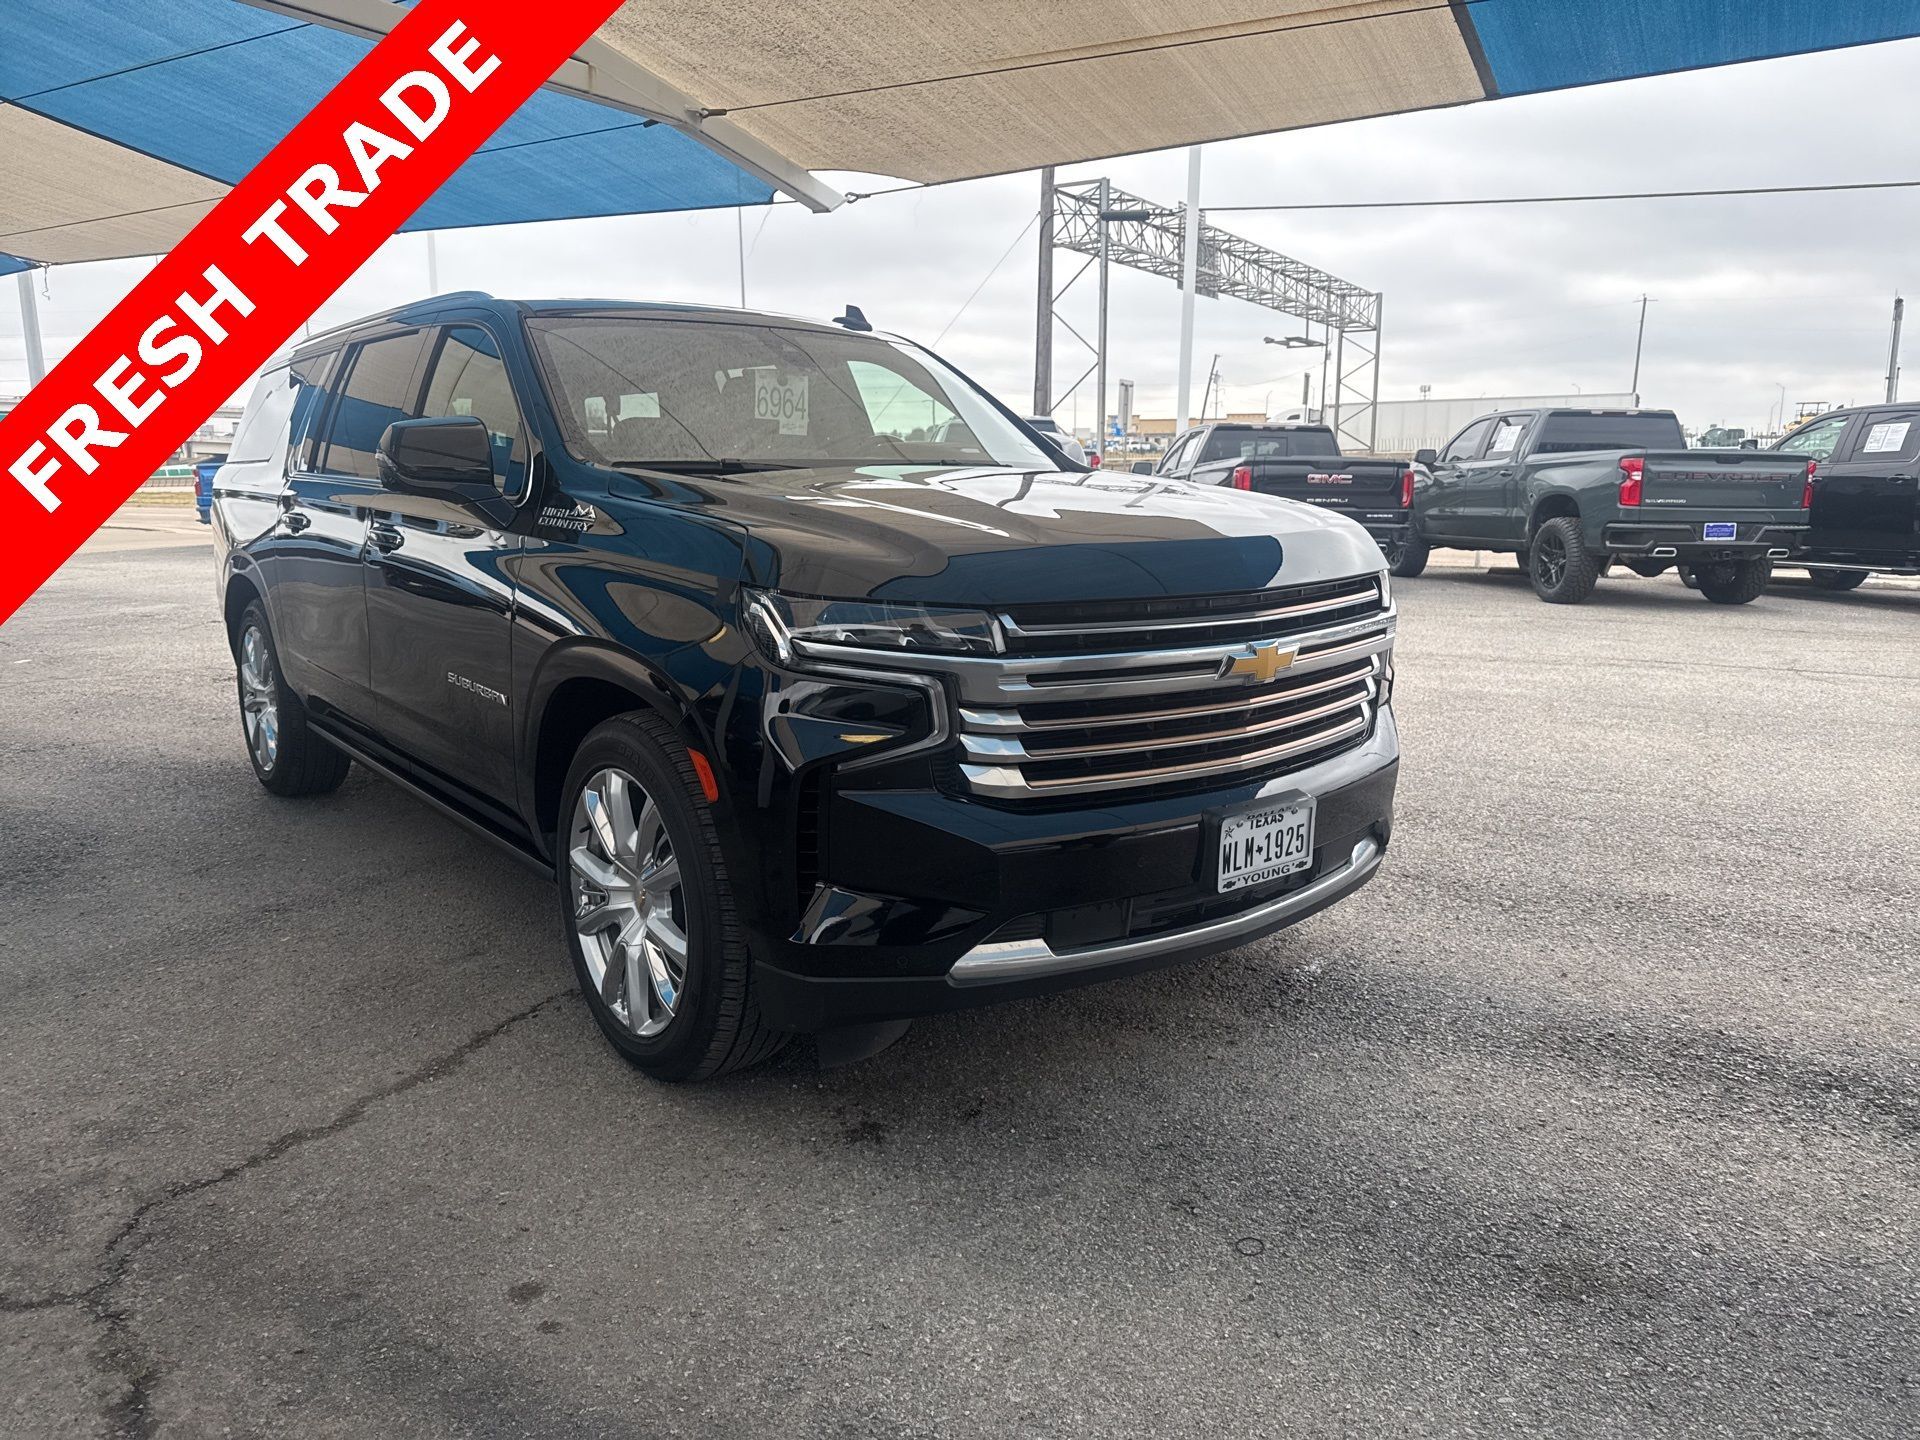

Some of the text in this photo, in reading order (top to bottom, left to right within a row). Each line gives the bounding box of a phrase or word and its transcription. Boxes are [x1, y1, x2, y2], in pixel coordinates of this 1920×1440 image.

[757, 386, 807, 420] 6964
[1307, 473, 1353, 485] GMC
[1657, 471, 1798, 483] CHEVROLET
[542, 506, 571, 518] HIGH
[538, 516, 594, 532] COUNTRY
[447, 671, 509, 706] SUBURBAN
[1250, 813, 1284, 830] TEXAS
[1242, 865, 1290, 884] YOUNG
